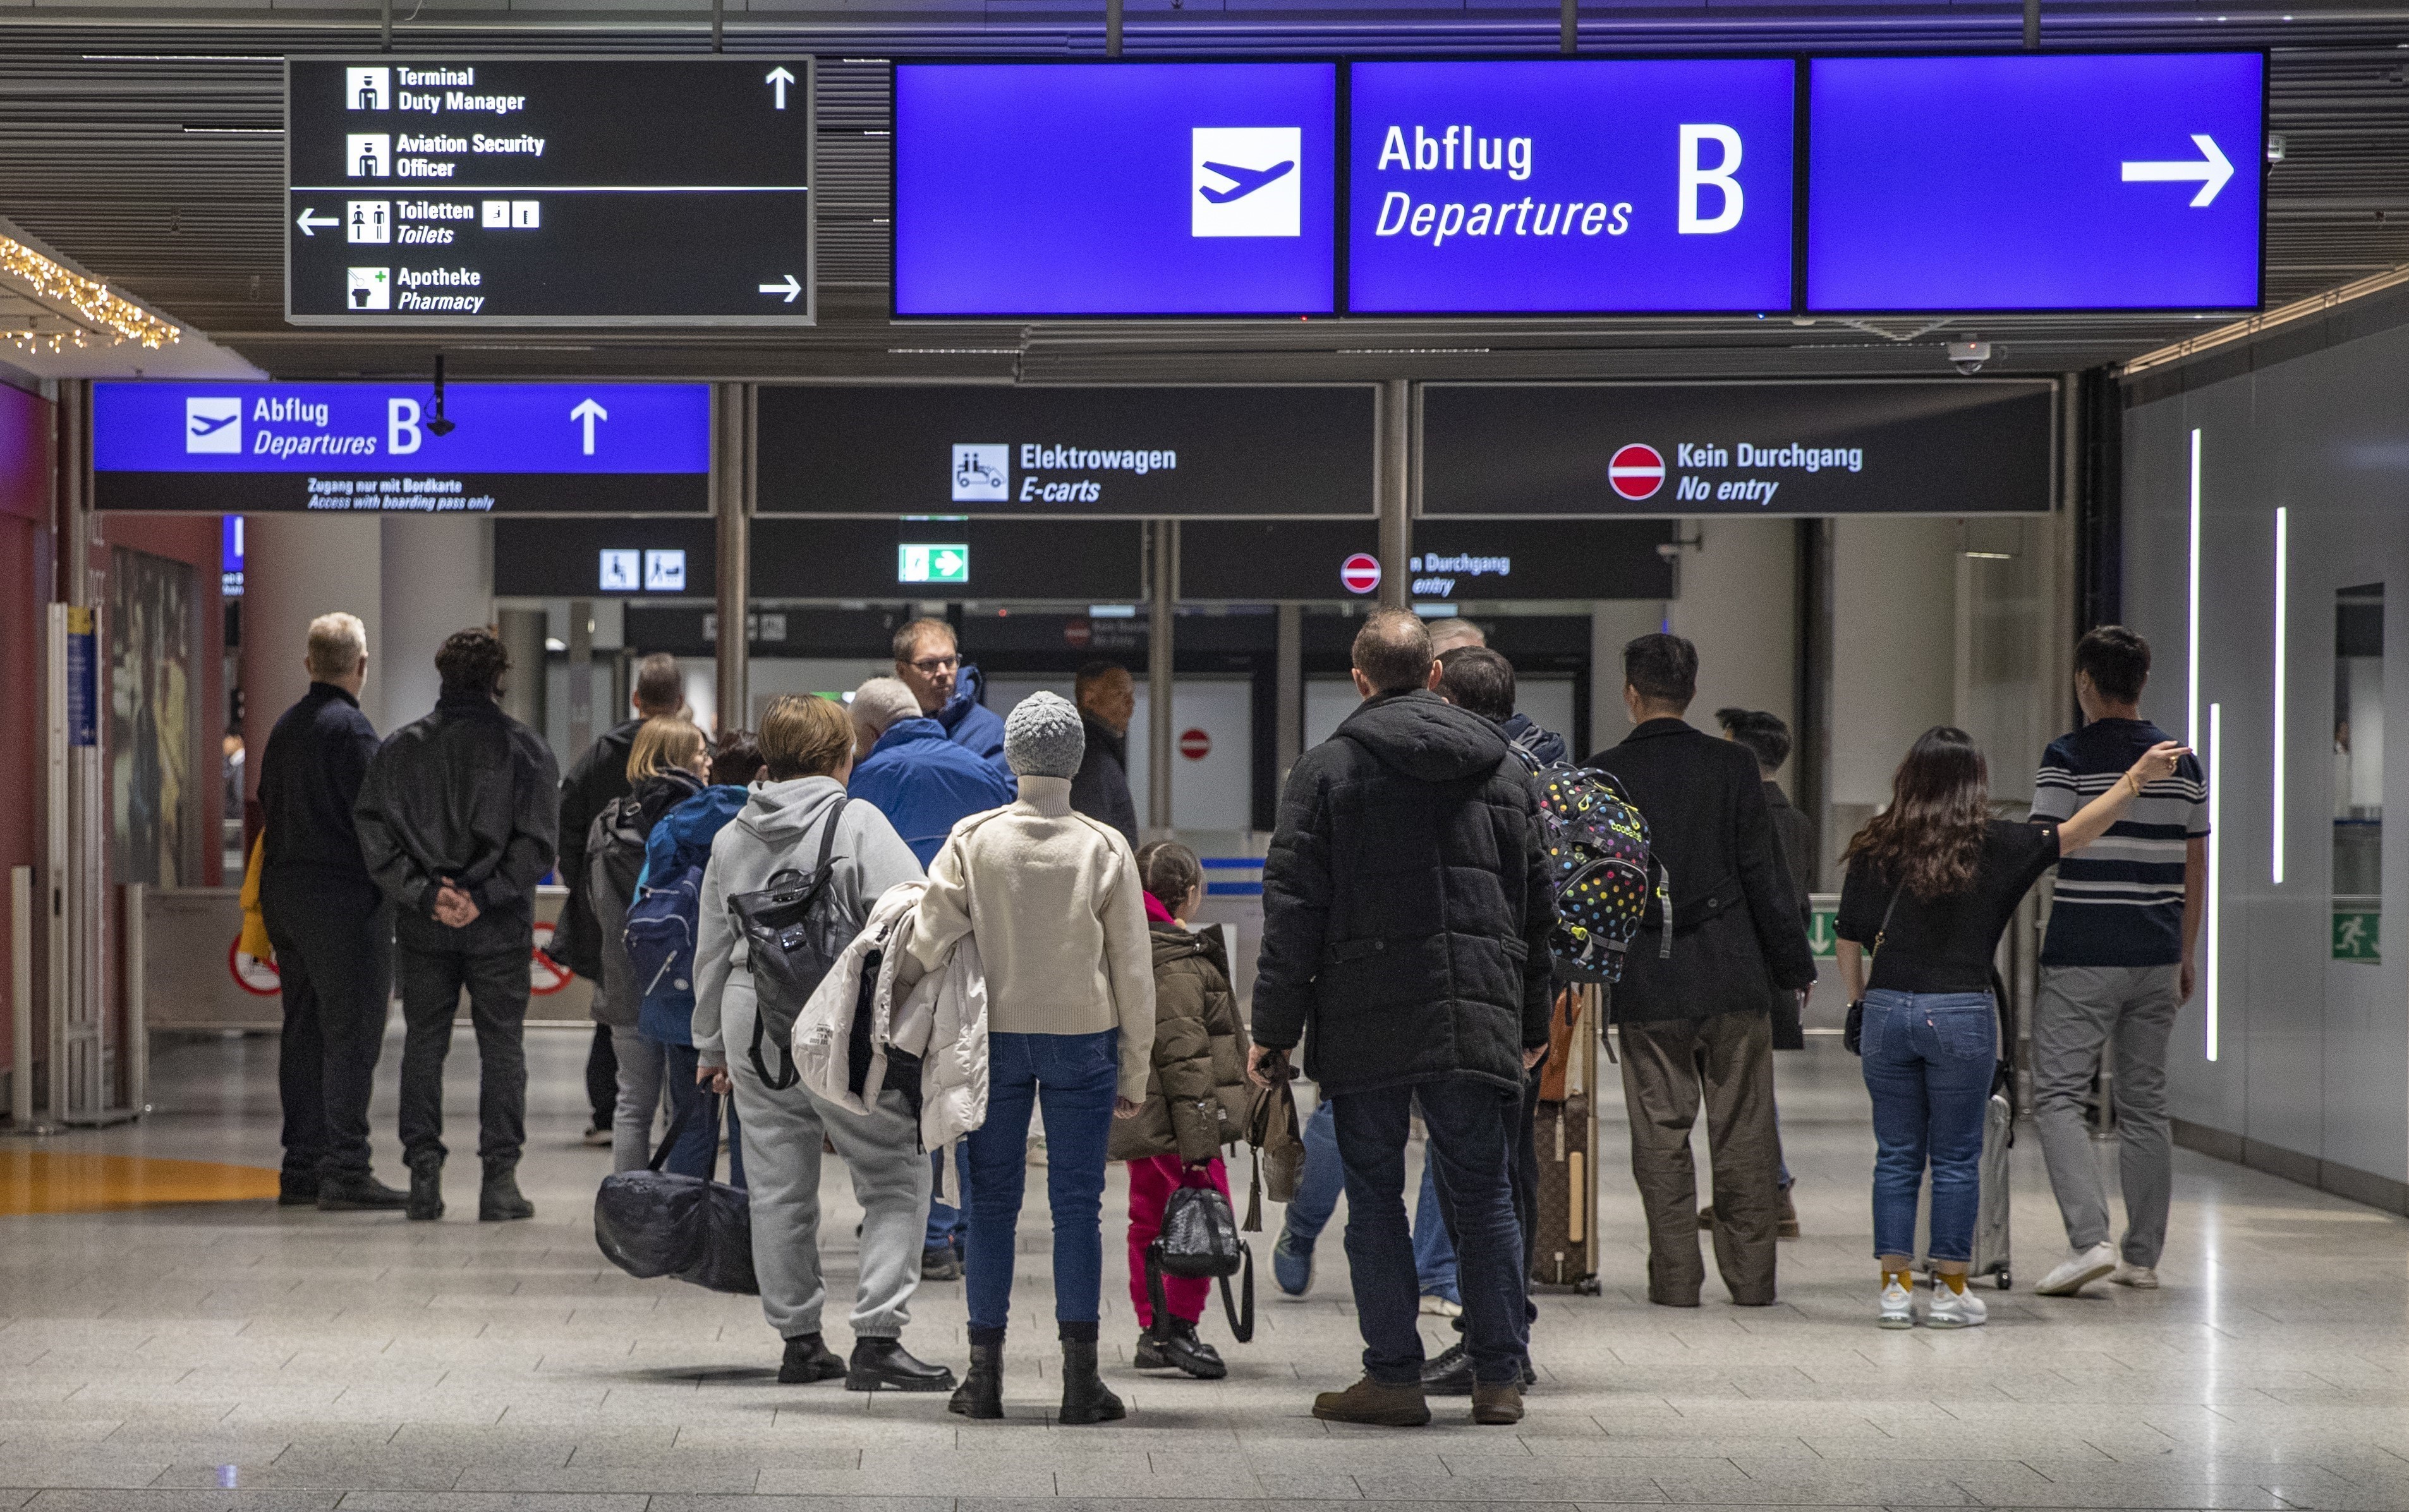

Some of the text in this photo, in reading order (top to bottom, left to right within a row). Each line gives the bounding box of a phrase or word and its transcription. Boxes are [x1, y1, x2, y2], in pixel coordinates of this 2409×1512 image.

[397, 67, 473, 86] Terminal
[399, 91, 526, 114] Duty Manager
[396, 133, 545, 157] Aviation Security
[1378, 125, 1532, 181] Abflug
[397, 158, 456, 178] Officer
[1678, 123, 1744, 234] B
[396, 200, 474, 220] Toiletten
[1375, 191, 1633, 247] Departures
[397, 225, 454, 245] Toilets
[397, 267, 481, 289] Apotheke
[397, 291, 485, 314] Pharmacy
[253, 397, 329, 427] Abflug
[388, 398, 422, 455] B
[253, 430, 377, 459] Departures
[1020, 444, 1177, 475] Elektrowagen
[1677, 442, 1863, 473] Kein Durchgang
[308, 478, 463, 495] Zugang nur mit Bordkarte
[1019, 476, 1101, 503] E-carts
[1677, 476, 1779, 505] No entry
[308, 495, 495, 512] Access with boarding pass only
[1425, 553, 1511, 576] Durchgang
[1412, 578, 1455, 598] entry
